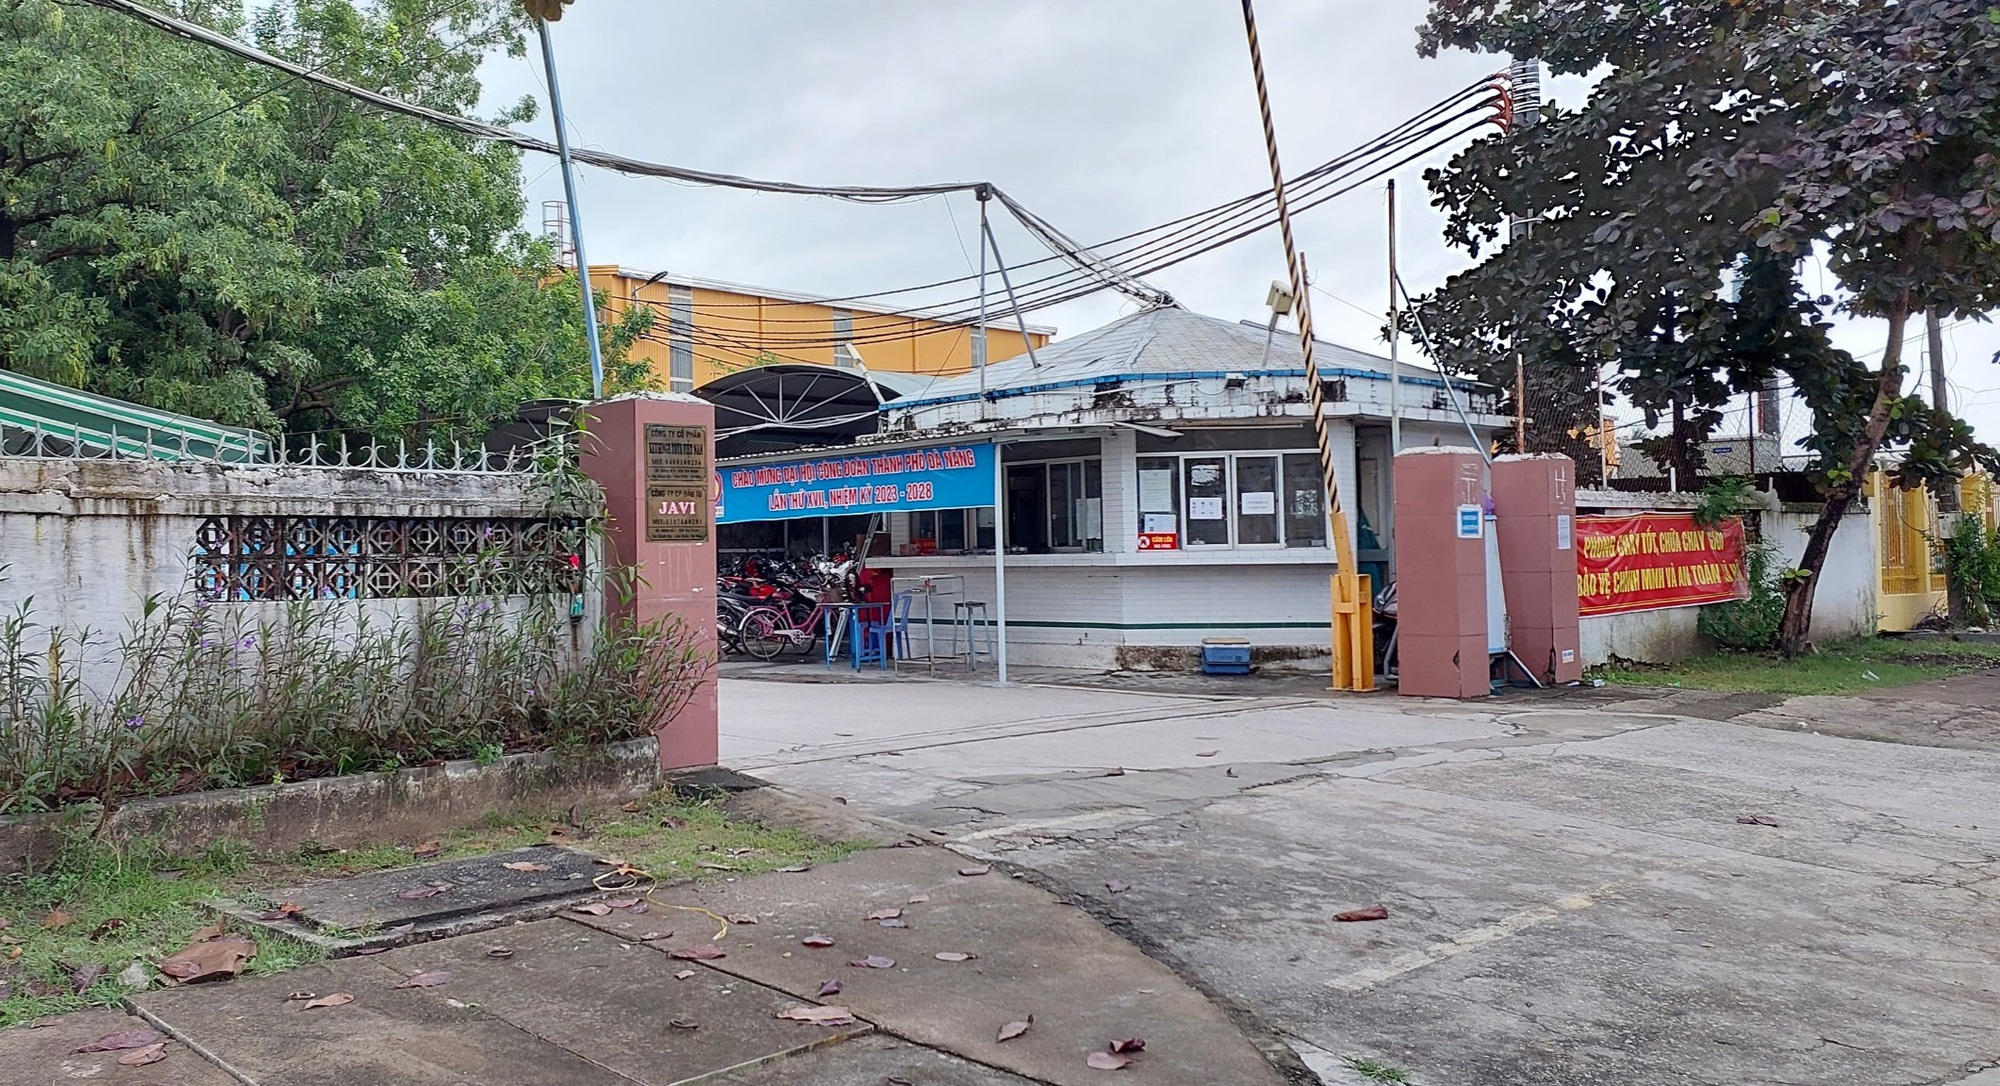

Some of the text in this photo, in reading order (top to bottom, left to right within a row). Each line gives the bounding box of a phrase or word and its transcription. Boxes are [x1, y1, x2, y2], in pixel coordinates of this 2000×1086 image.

[651, 428, 667, 438] CÔNG
[668, 430, 675, 438] TY
[731, 468, 755, 488] CHÀO
[755, 466, 782, 486] MỪNG
[783, 465, 799, 486] ĐẠI
[800, 461, 816, 485] HỘI
[817, 459, 842, 480] CÔNG
[843, 456, 870, 478] ĐOÀN
[871, 453, 903, 475] THÀNH
[904, 449, 926, 472] PHỐ
[926, 449, 943, 470] ĐÀ
[651, 488, 666, 497] CÔNG
[806, 490, 829, 509] XVII,
[828, 485, 858, 509] NHIỆM
[874, 484, 898, 504] 2023
[906, 481, 933, 502] 2028
[658, 501, 697, 515] JAVI
[1583, 531, 1616, 559] PHÒNG
[1616, 529, 1640, 557] CHÁY
[1641, 525, 1659, 556] TỐT,
[1659, 528, 1681, 553] CHỮA
[1577, 566, 1597, 597] BẢO
[1598, 567, 1611, 600] VỆ
[1613, 565, 1640, 594] CHÍNH
[1665, 562, 1677, 588] VÀ
[1678, 565, 1692, 587] AN
[1691, 559, 1721, 586] TOÀN
